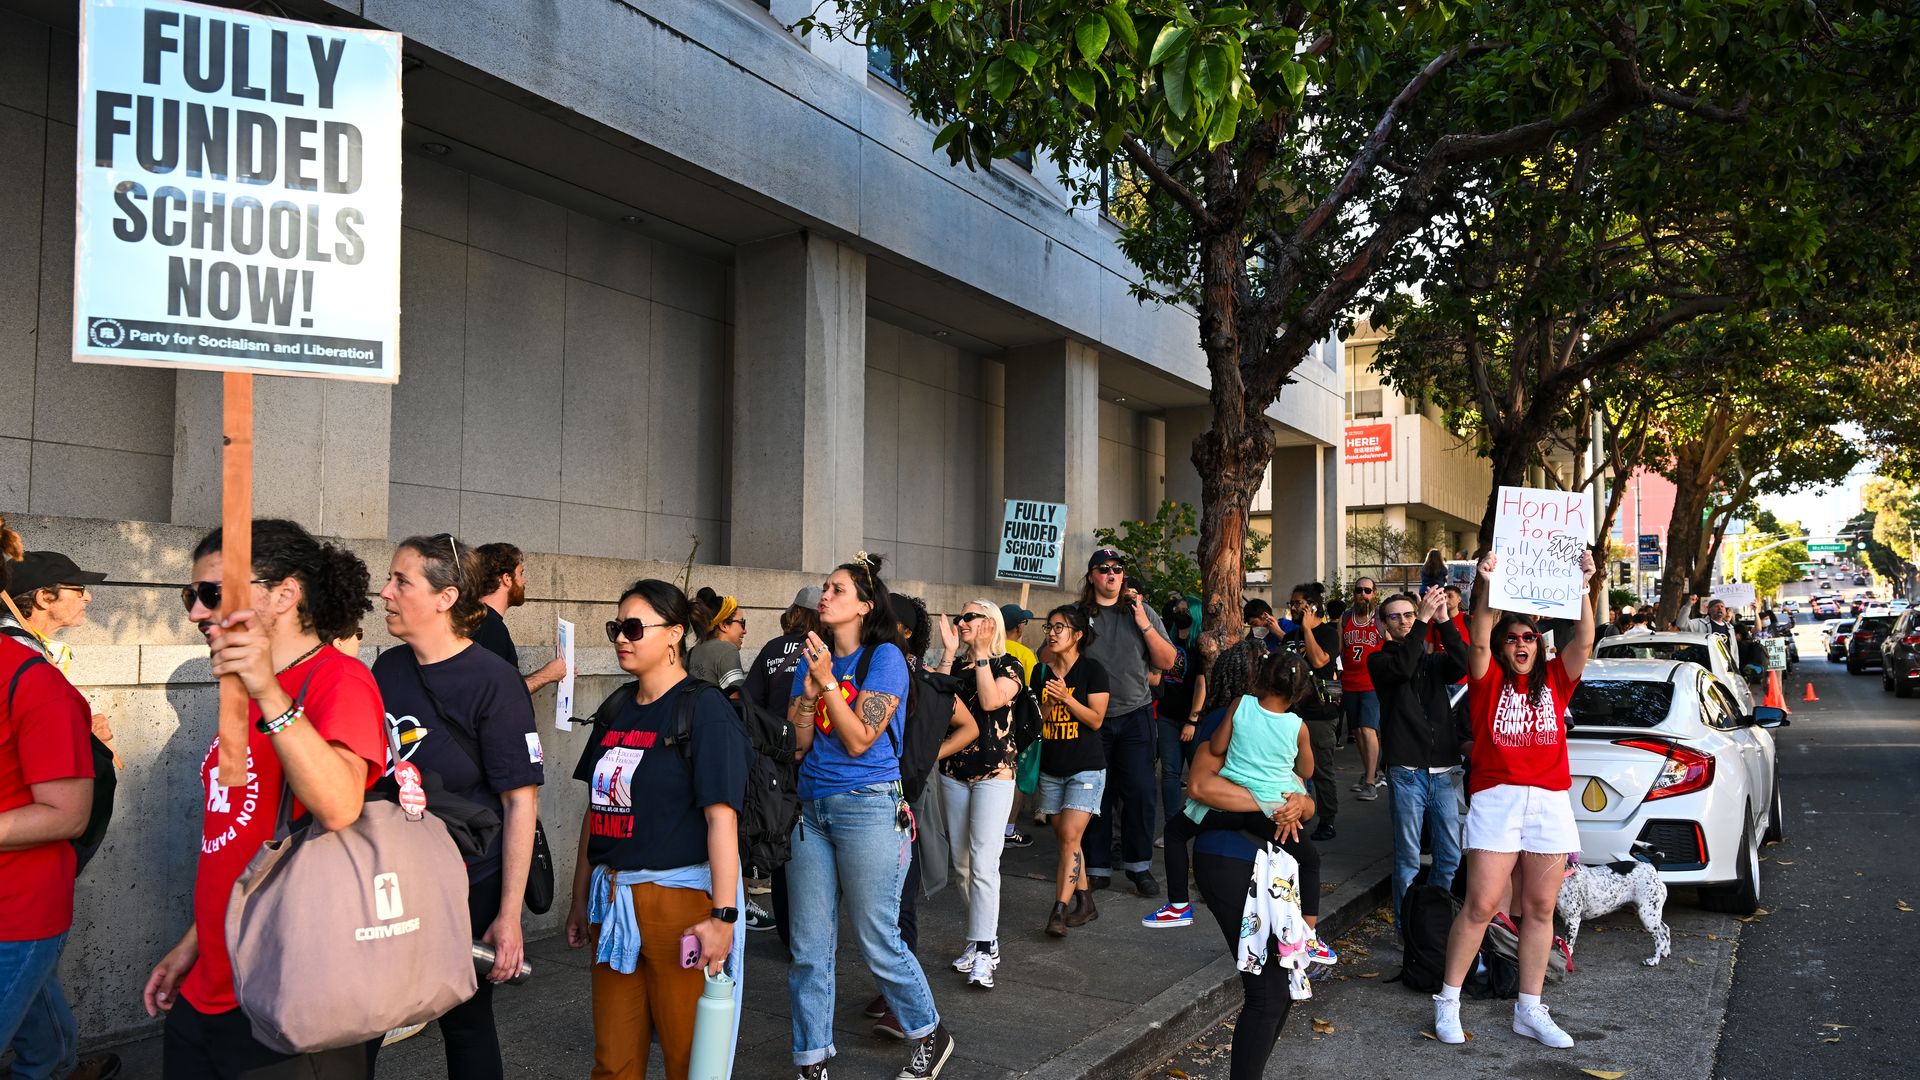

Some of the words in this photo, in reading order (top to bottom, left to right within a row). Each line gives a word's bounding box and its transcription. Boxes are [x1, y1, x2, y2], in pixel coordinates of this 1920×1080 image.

[143, 8, 346, 110] FULLY
[95, 89, 363, 195] FUNDED
[113, 180, 365, 266] SCHOOLS
[167, 255, 314, 328] NOW!
[129, 329, 170, 347] Party
[173, 331, 196, 345] for
[198, 334, 270, 352] Socialism
[273, 341, 300, 355] and
[303, 343, 374, 361] Liberation
[1346, 436, 1379, 448] HERE!
[1014, 502, 1056, 523] FULLY
[1003, 520, 1058, 543] FUNDED
[1519, 518, 1567, 540] for
[1005, 540, 1056, 559] SCHOOLS
[1495, 536, 1543, 566] Fully
[1013, 556, 1044, 573] NOW!
[1505, 558, 1573, 578] Staffed
[1503, 577, 1581, 601] Schools!
[1352, 646, 1364, 662] 7
[1043, 721, 1079, 740] MATTER
[1493, 719, 1535, 734] FUNNY
[1535, 717, 1559, 732] GIRL
[1493, 731, 1535, 747] FUNNY
[1535, 731, 1558, 745] GIRL
